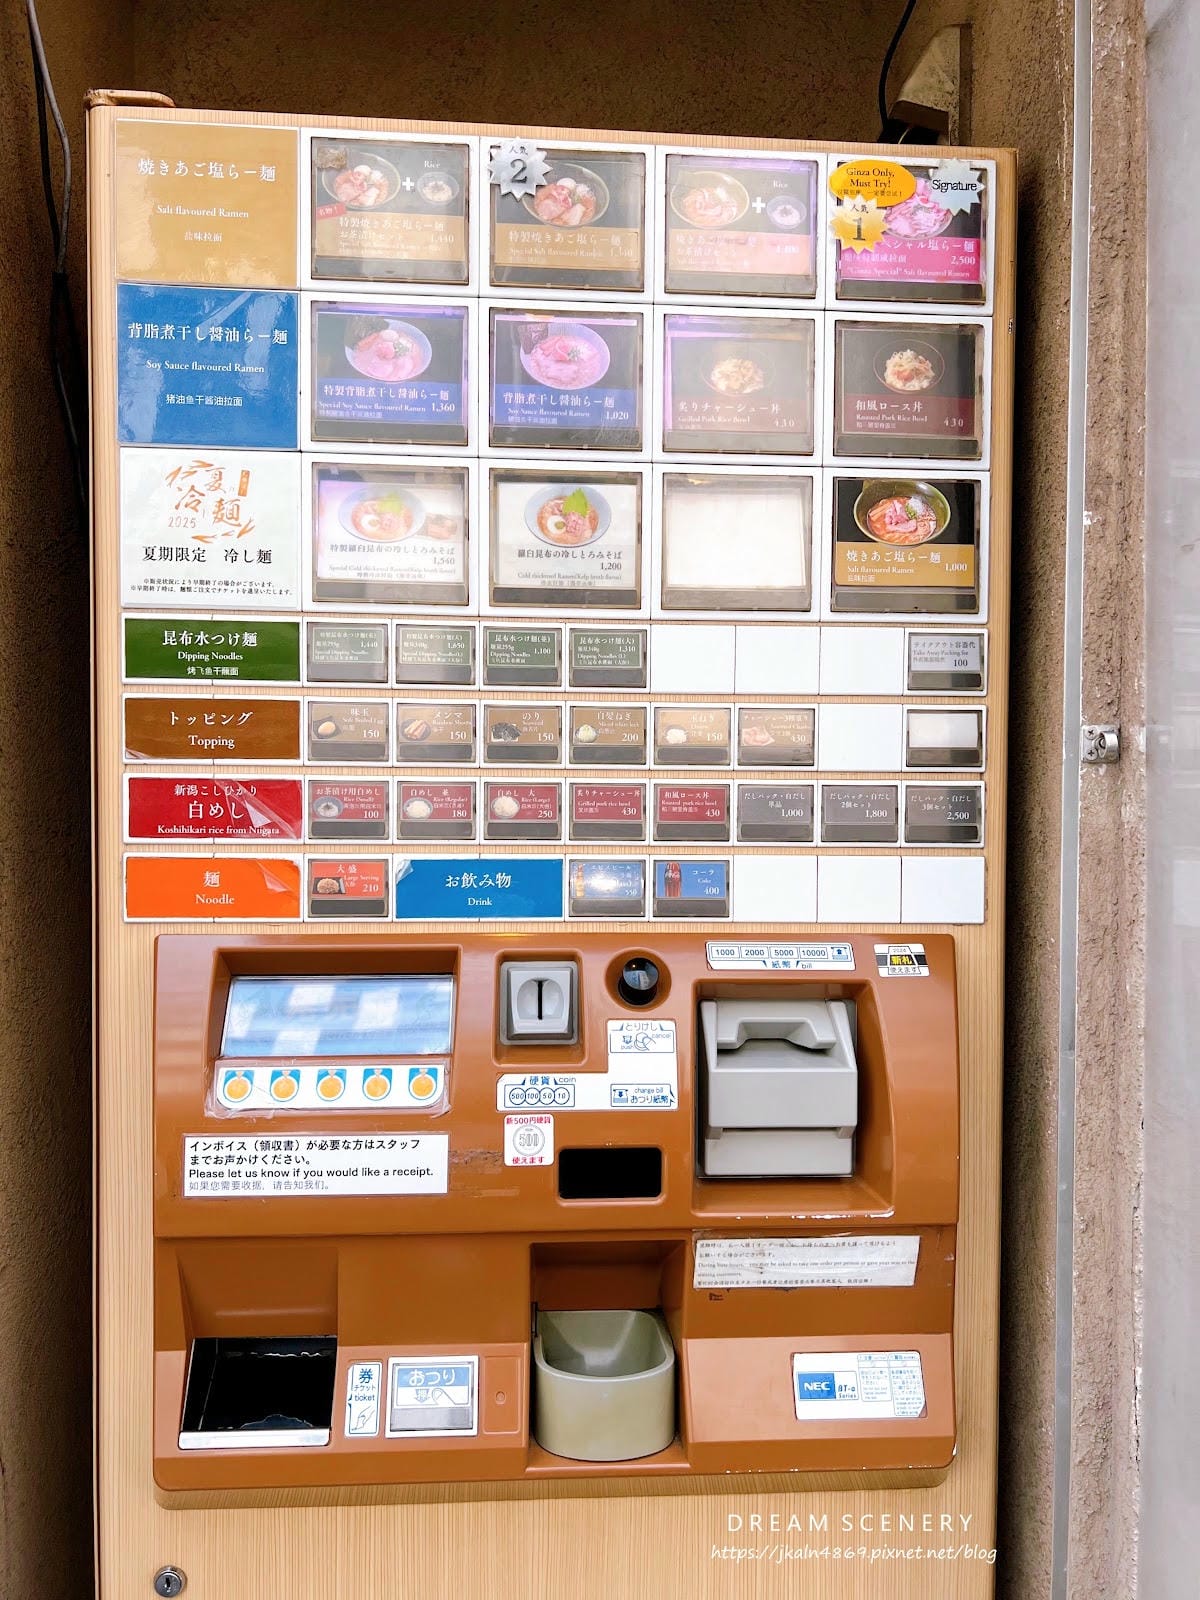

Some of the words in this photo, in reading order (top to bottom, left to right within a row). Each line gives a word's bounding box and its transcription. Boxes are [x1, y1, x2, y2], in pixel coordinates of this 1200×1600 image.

[424, 160, 440, 168] Rice
[138, 158, 276, 182] 焼きあご塩らー麺
[511, 159, 527, 183] 2
[846, 168, 870, 177] Ginza
[873, 168, 895, 177] Only,
[850, 179, 870, 187] Must
[874, 179, 891, 188] Try!
[932, 180, 977, 192] Signature
[157, 205, 173, 215] Salt
[176, 207, 216, 218] flavoured
[219, 209, 249, 218] Ramen
[852, 217, 865, 240] 1
[951, 256, 975, 265] 2,500
[128, 323, 288, 346] 背脂煮干し醤油らー麺
[146, 360, 162, 371] Soy
[164, 361, 189, 370] Sauce
[192, 362, 232, 372] flavoured
[234, 364, 265, 373] Ramen
[432, 403, 455, 412] 1,360
[856, 400, 923, 412] 和風ロース丼
[605, 411, 629, 420] 1,020
[944, 417, 963, 427] 430
[142, 546, 206, 562] 夏期限定
[224, 548, 272, 564] 冷し麺
[846, 550, 941, 564] 焼きあご塩らー麺
[601, 562, 621, 571] 1,200
[945, 563, 967, 572] 1,000
[162, 631, 258, 647] 昆布水つけ麺
[178, 652, 209, 661] Dipping
[211, 652, 243, 660] Noodles
[171, 712, 253, 725] トッピング
[363, 730, 380, 738] 150
[450, 732, 466, 740] 150
[537, 733, 554, 741] 150
[622, 733, 639, 742] 200
[706, 733, 722, 741] 150
[188, 735, 235, 749] Topping
[174, 784, 257, 796] 新潟こしひかり
[529, 789, 535, 797] 大
[665, 791, 709, 799] 和風ロース丼
[189, 801, 244, 819] 白めし
[364, 810, 379, 818] 100
[452, 809, 467, 817] 180
[537, 810, 552, 818] 250
[781, 809, 803, 817] 1,000
[865, 810, 887, 818] 1,800
[947, 812, 969, 820] 2,500
[158, 825, 206, 834] Koshihikari
[208, 826, 224, 834] rice
[336, 864, 357, 874] 大盛
[204, 871, 220, 887] 麺
[446, 872, 511, 888] お飲み物
[362, 884, 378, 892] 210
[704, 887, 719, 895] 400
[195, 894, 234, 904] Noodle
[468, 898, 492, 906] Drink
[625, 1022, 658, 1031] とりけし
[530, 1076, 549, 1085] 硬貨
[190, 1139, 420, 1152] インボイス（領収書）が必要な方はスタッフ
[190, 1154, 311, 1165] までお声かけください。
[189, 1169, 224, 1178] Please
[227, 1170, 242, 1178] let
[261, 1169, 289, 1178] know
[293, 1168, 300, 1177] if
[303, 1169, 323, 1179] you
[326, 1168, 358, 1177] would
[362, 1168, 380, 1176] like
[392, 1167, 433, 1178] receipt.
[360, 1368, 373, 1383] 券
[409, 1369, 455, 1386] おつり
[804, 1382, 830, 1391] NEC
